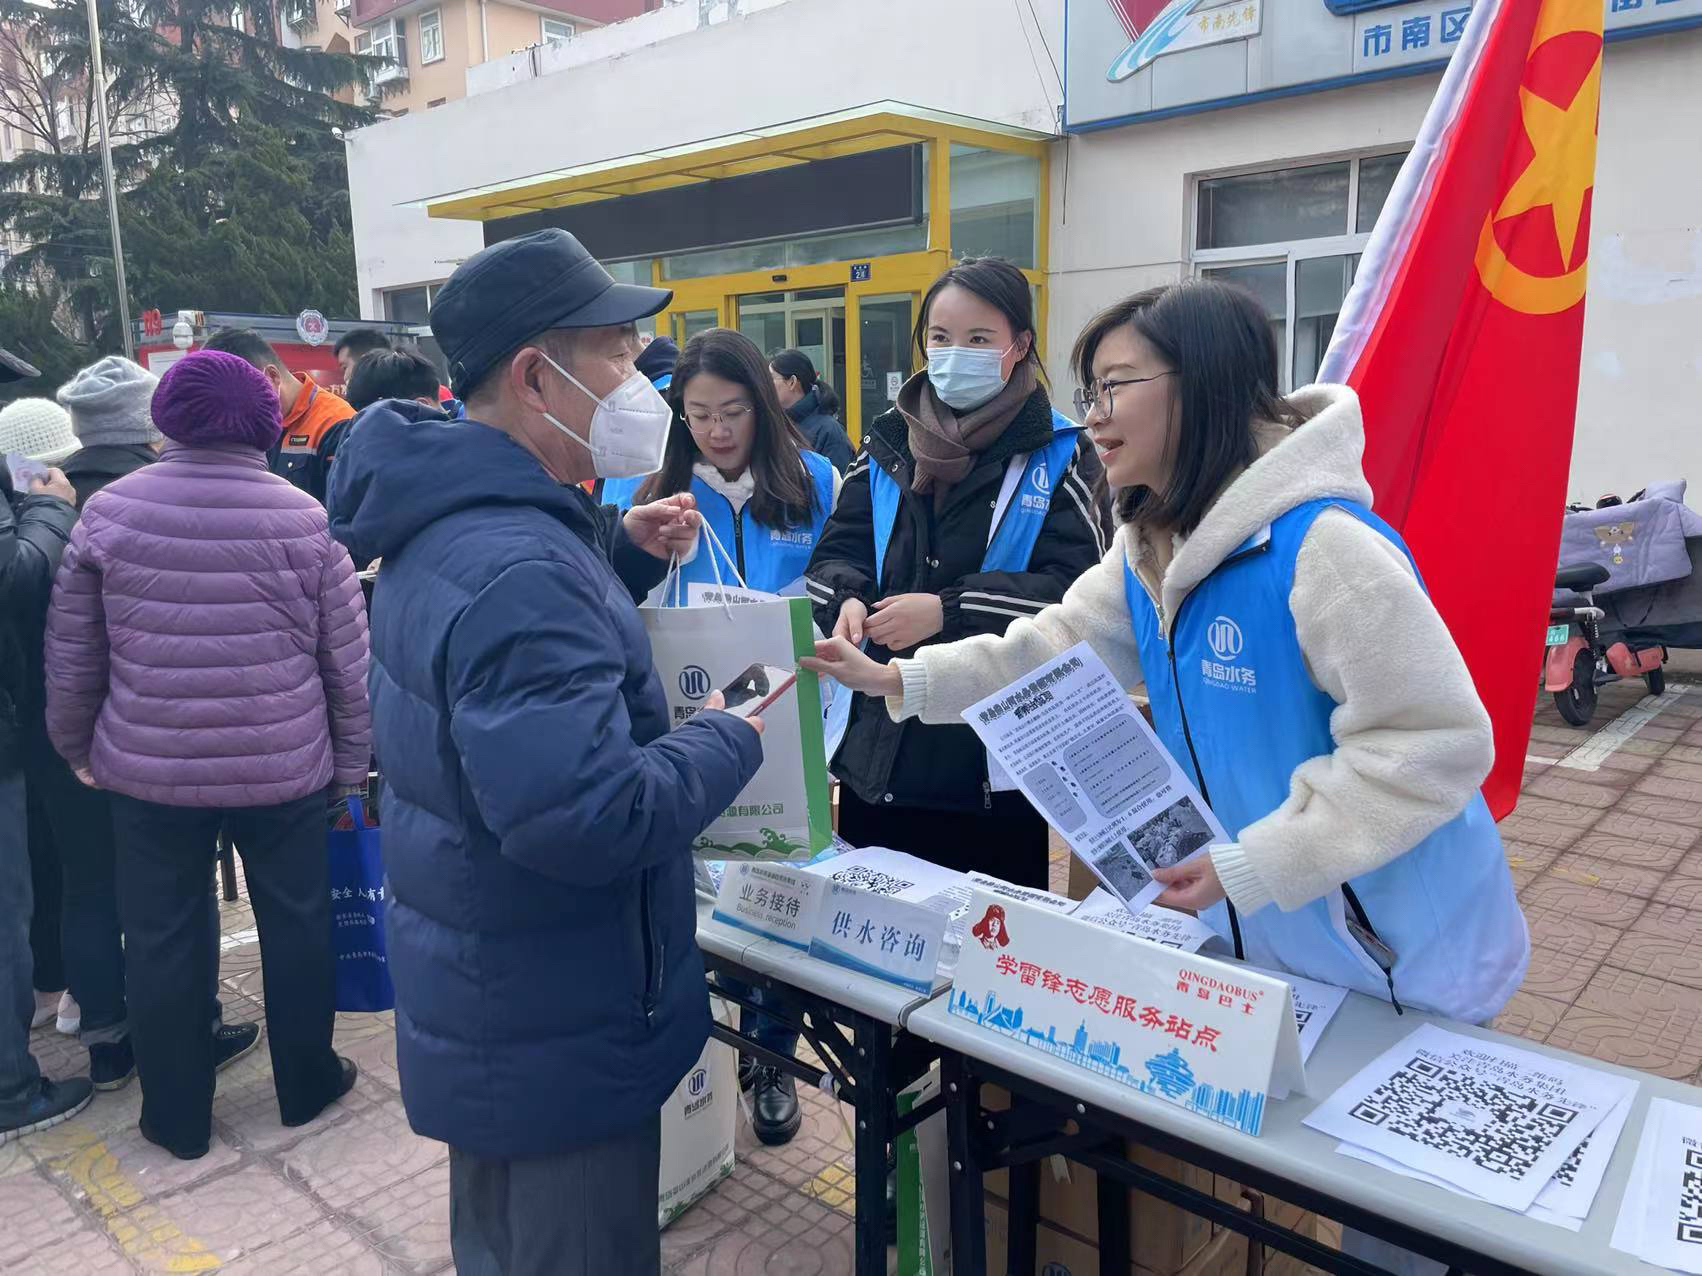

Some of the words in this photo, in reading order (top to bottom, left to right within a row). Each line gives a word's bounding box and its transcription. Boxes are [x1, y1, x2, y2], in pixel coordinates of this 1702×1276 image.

[1363, 7, 1471, 57] 市南区
[1202, 660, 1257, 686] 青岛水务
[674, 705, 704, 720] 青岛
[739, 883, 801, 918] 业务接待
[765, 914, 796, 930] reception
[832, 910, 926, 962] 供水咨询
[995, 954, 1222, 1053] 学雷锋志愿服务站点
[1176, 981, 1255, 1015] 青岛巴士
